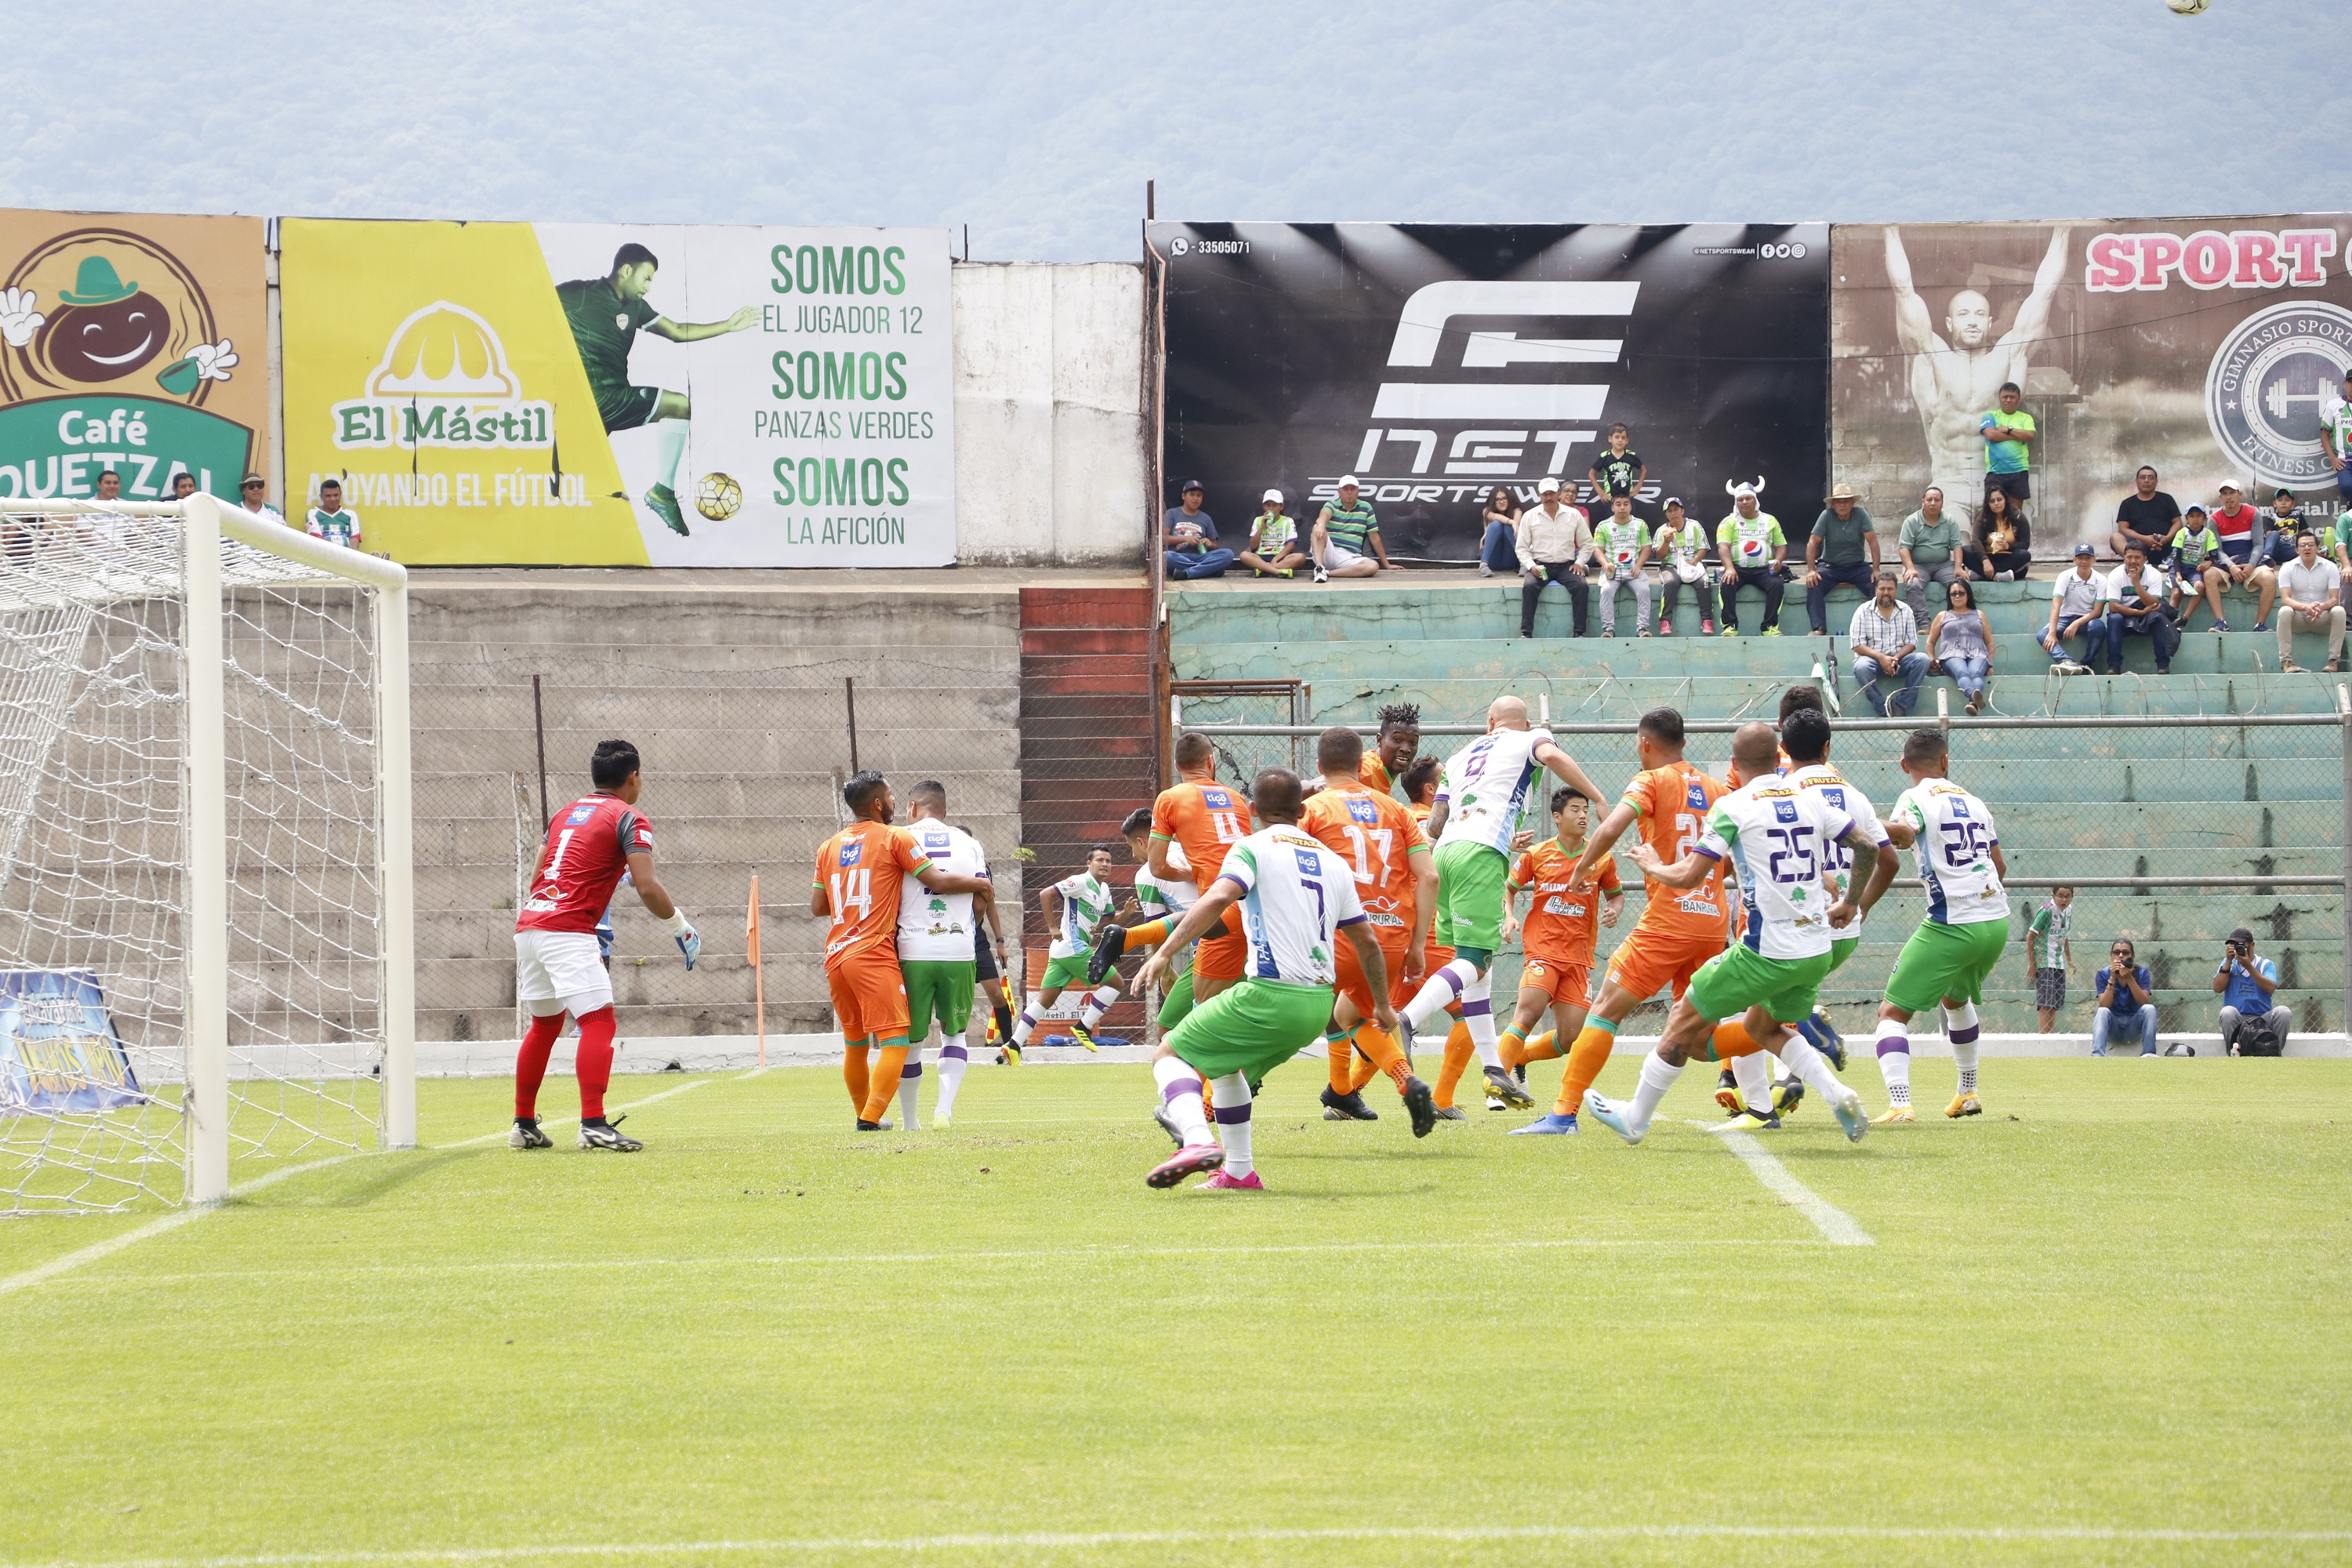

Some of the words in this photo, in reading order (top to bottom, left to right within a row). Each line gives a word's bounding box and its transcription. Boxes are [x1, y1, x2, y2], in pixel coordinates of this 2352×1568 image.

[771, 244, 906, 296] SOMOS
[1198, 241, 1250, 254] 33505071
[2089, 232, 2333, 289] SPORT
[763, 304, 788, 332] EL
[794, 304, 891, 334] JUGADOR
[899, 306, 923, 334] 12
[771, 350, 907, 401] SOMOS
[2223, 321, 2292, 392] GIMNASIO
[58, 408, 148, 446] Café
[338, 405, 387, 443] El
[401, 405, 547, 443] Mástil
[754, 410, 842, 439] PANZAS
[848, 411, 934, 439] VERDES
[2241, 434, 2316, 474] FITNESS
[456, 473, 488, 506] EL
[772, 456, 909, 506] SOMOS
[786, 517, 815, 545] LA
[822, 511, 906, 545] AFICIÓN
[1212, 811, 1244, 844] 4
[1940, 822, 1991, 868] 26
[543, 829, 575, 880] 1
[1341, 825, 1393, 888] 17
[1766, 826, 1816, 884] 25
[830, 868, 873, 926] 14
[1301, 877, 1327, 942] 7
